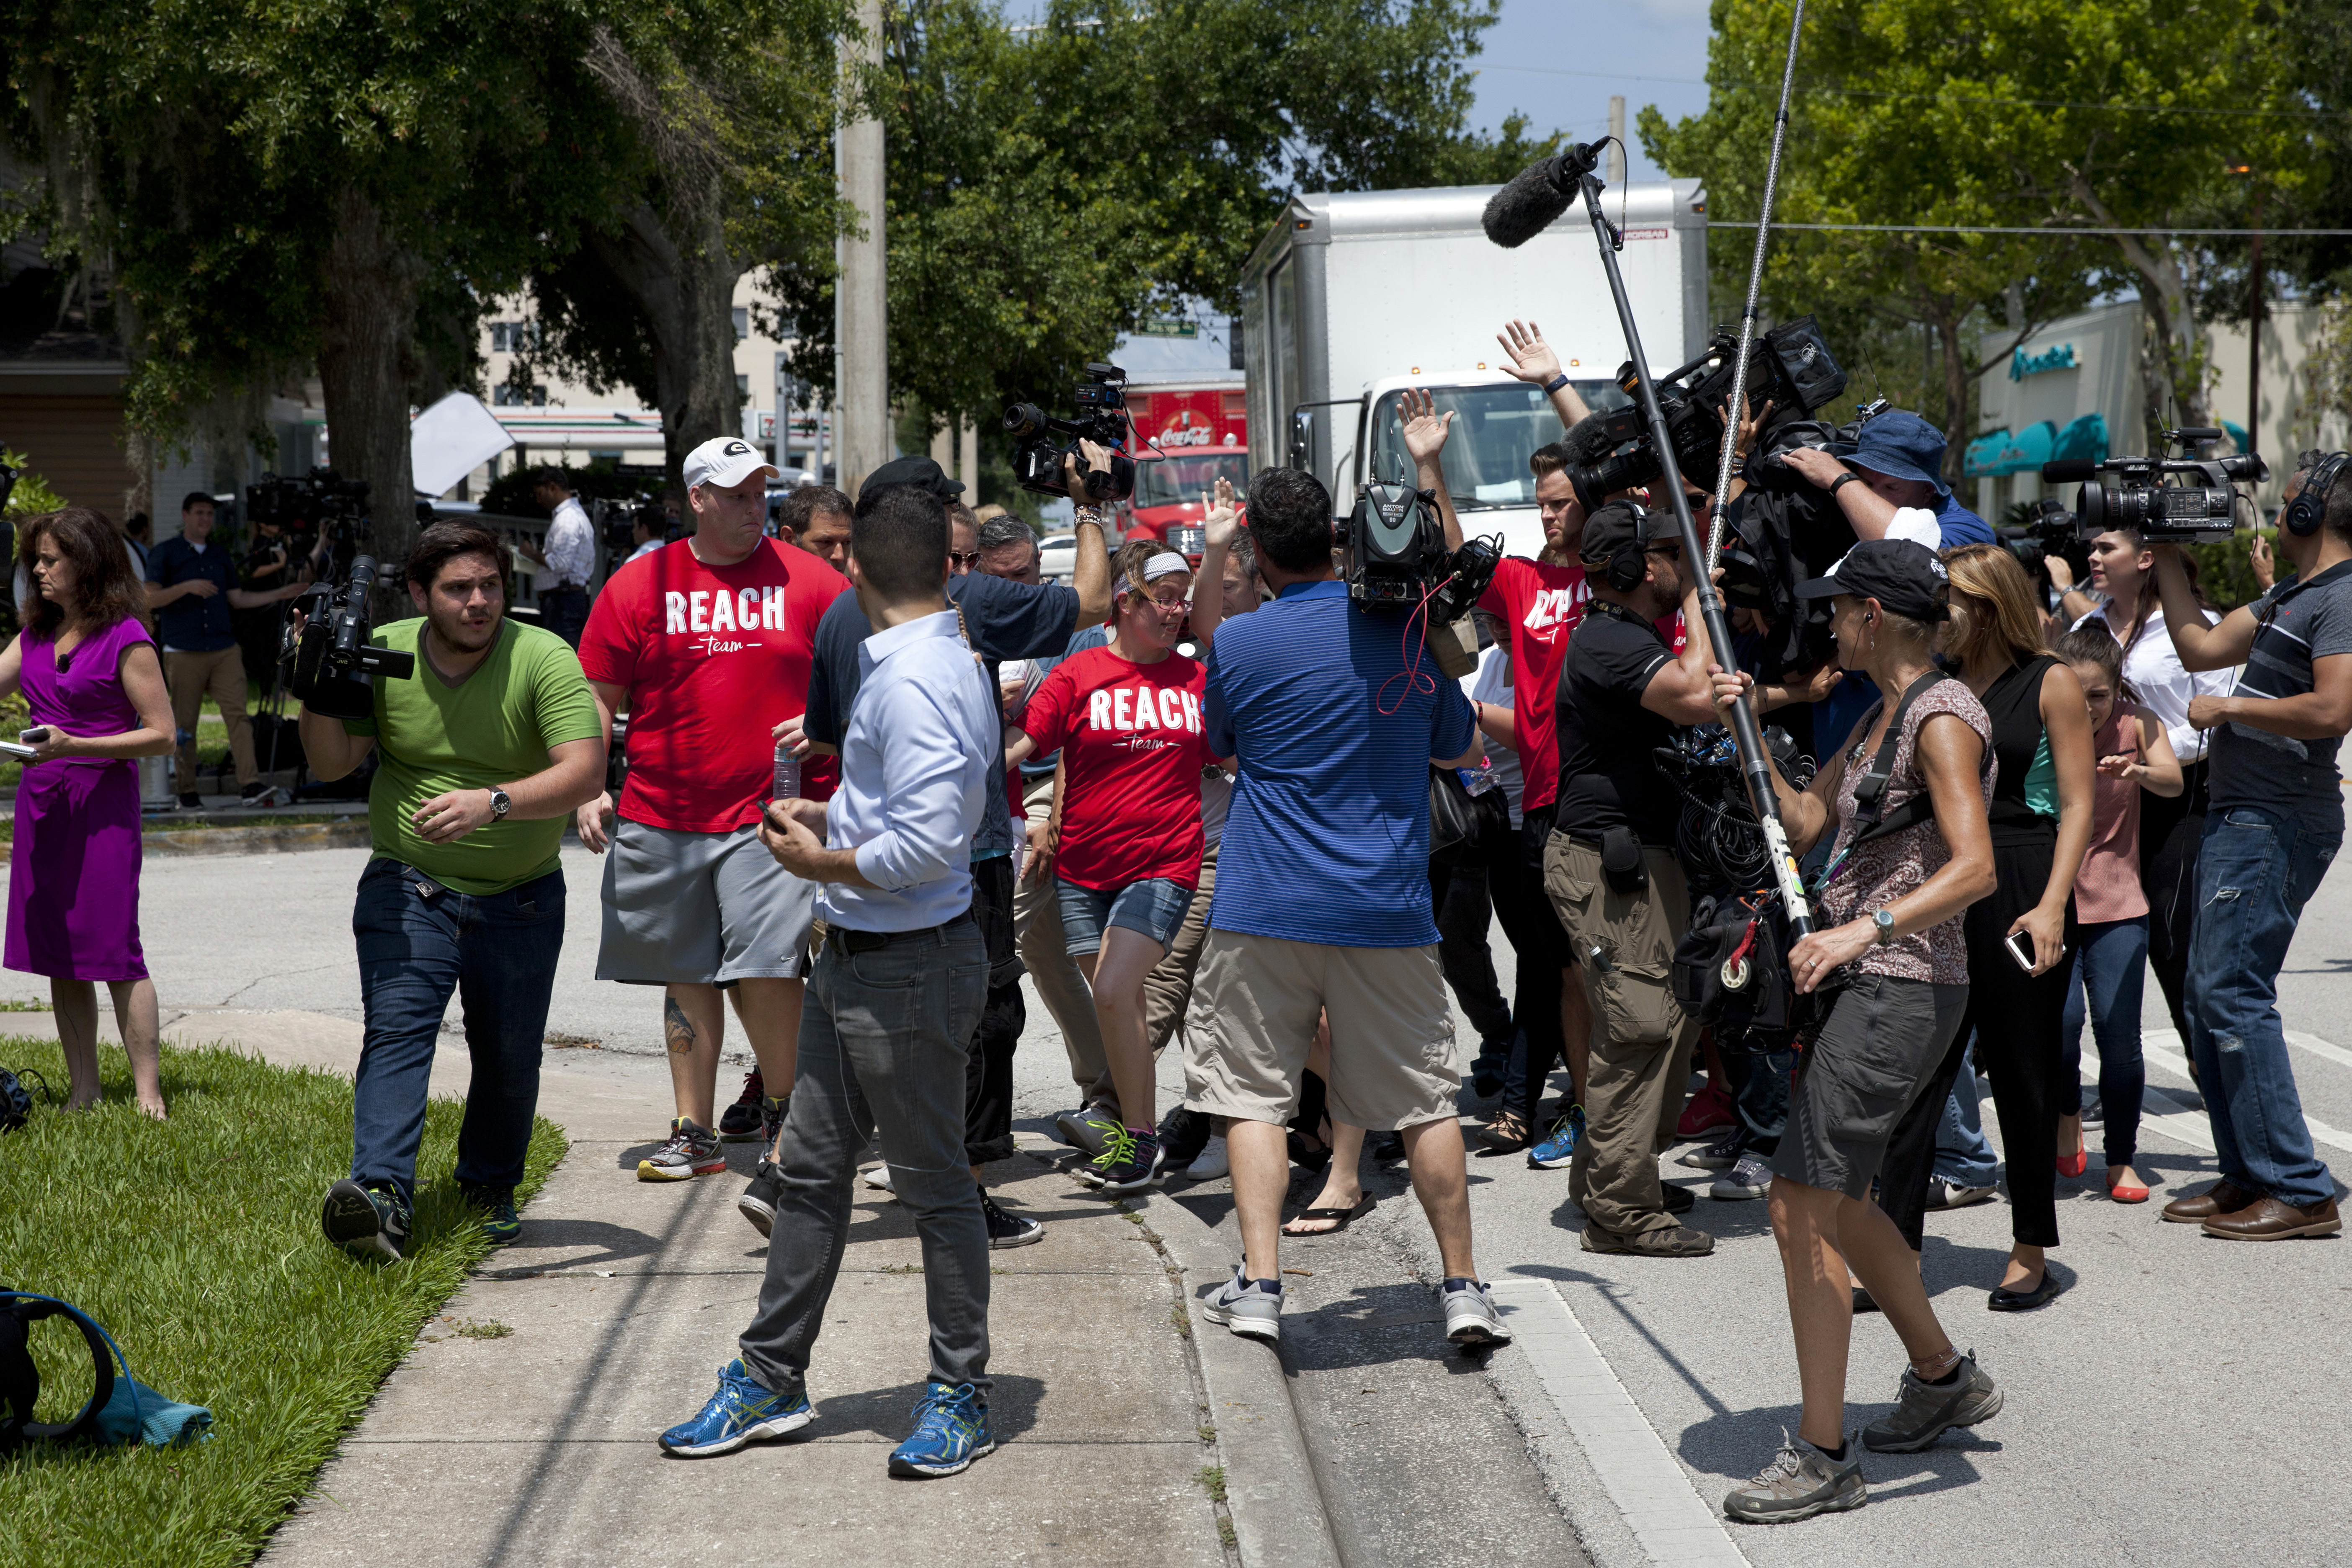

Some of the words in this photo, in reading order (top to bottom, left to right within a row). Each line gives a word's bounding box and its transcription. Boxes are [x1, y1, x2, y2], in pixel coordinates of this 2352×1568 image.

[1624, 231, 1664, 240] MORGAN
[1931, 562, 1946, 572] Rio
[665, 586, 784, 634] REACH
[699, 635, 743, 656] team
[1090, 686, 1201, 737] REACH
[1123, 733, 1164, 752] team
